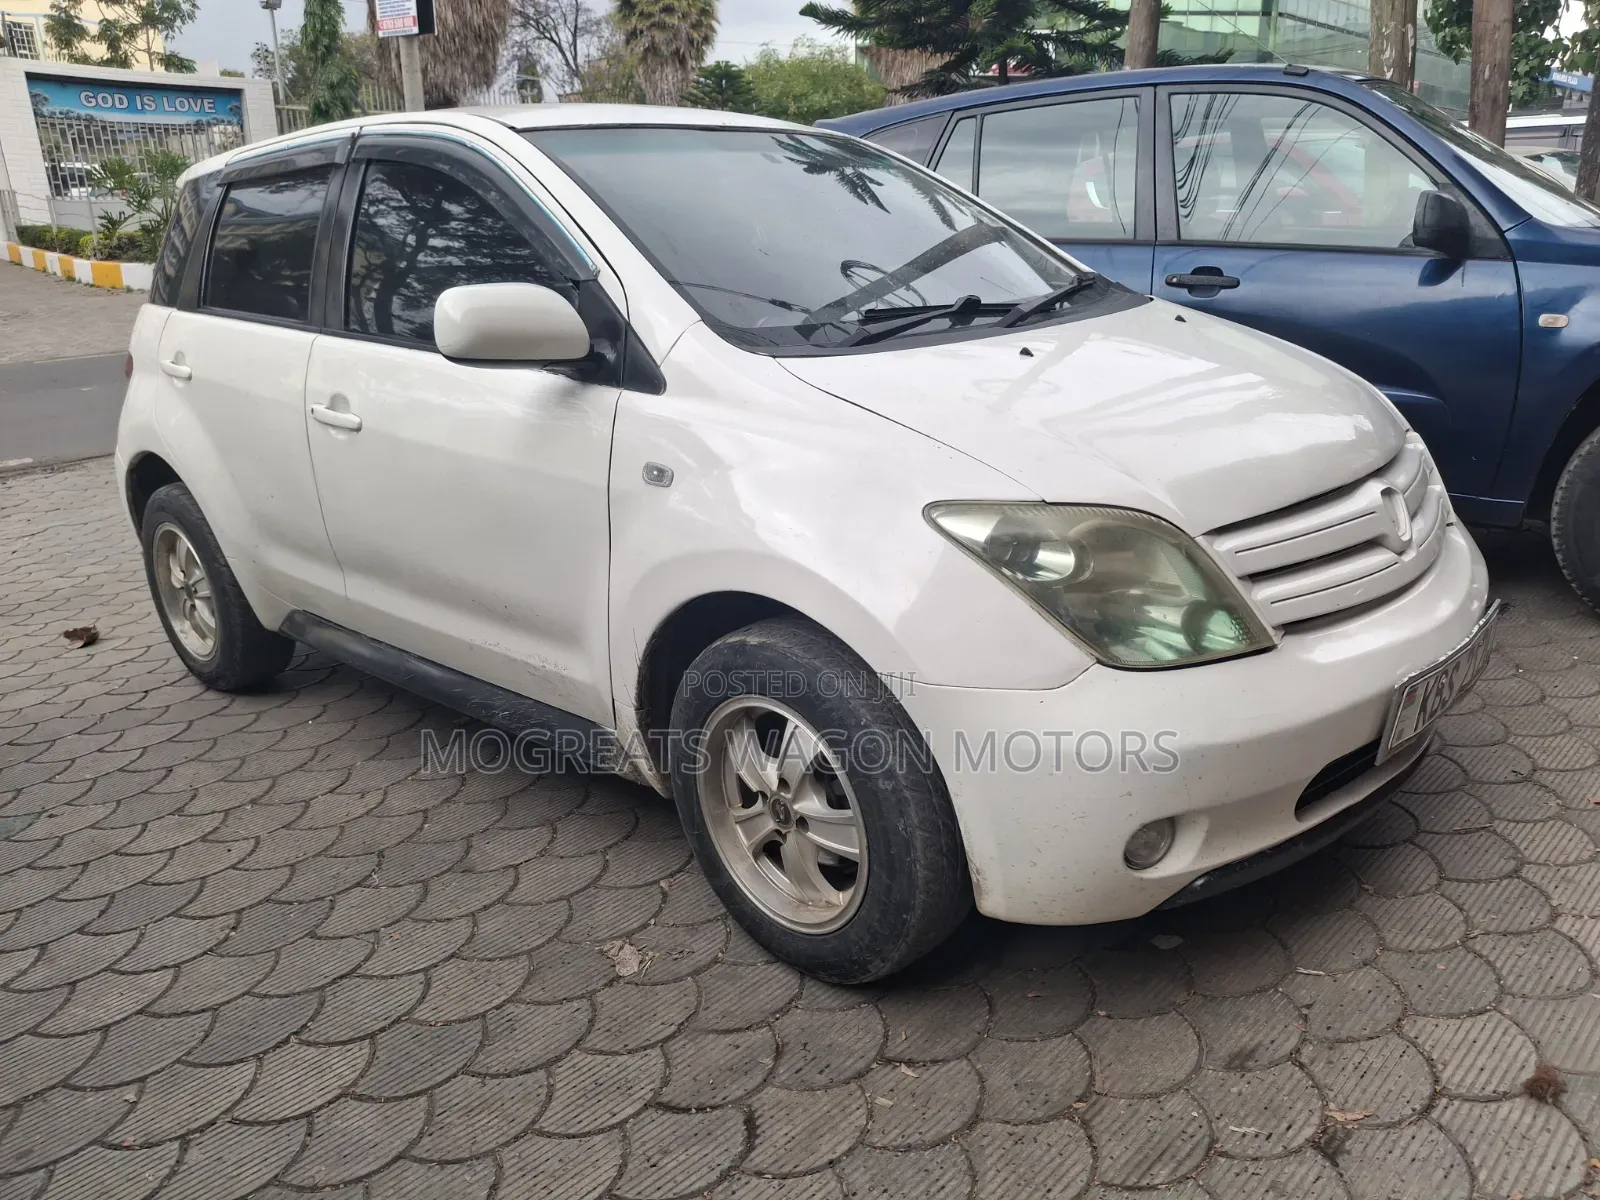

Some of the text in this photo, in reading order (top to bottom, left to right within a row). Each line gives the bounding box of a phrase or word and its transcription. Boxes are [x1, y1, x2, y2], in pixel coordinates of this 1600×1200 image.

[79, 90, 216, 114] GOD IS LOVE
